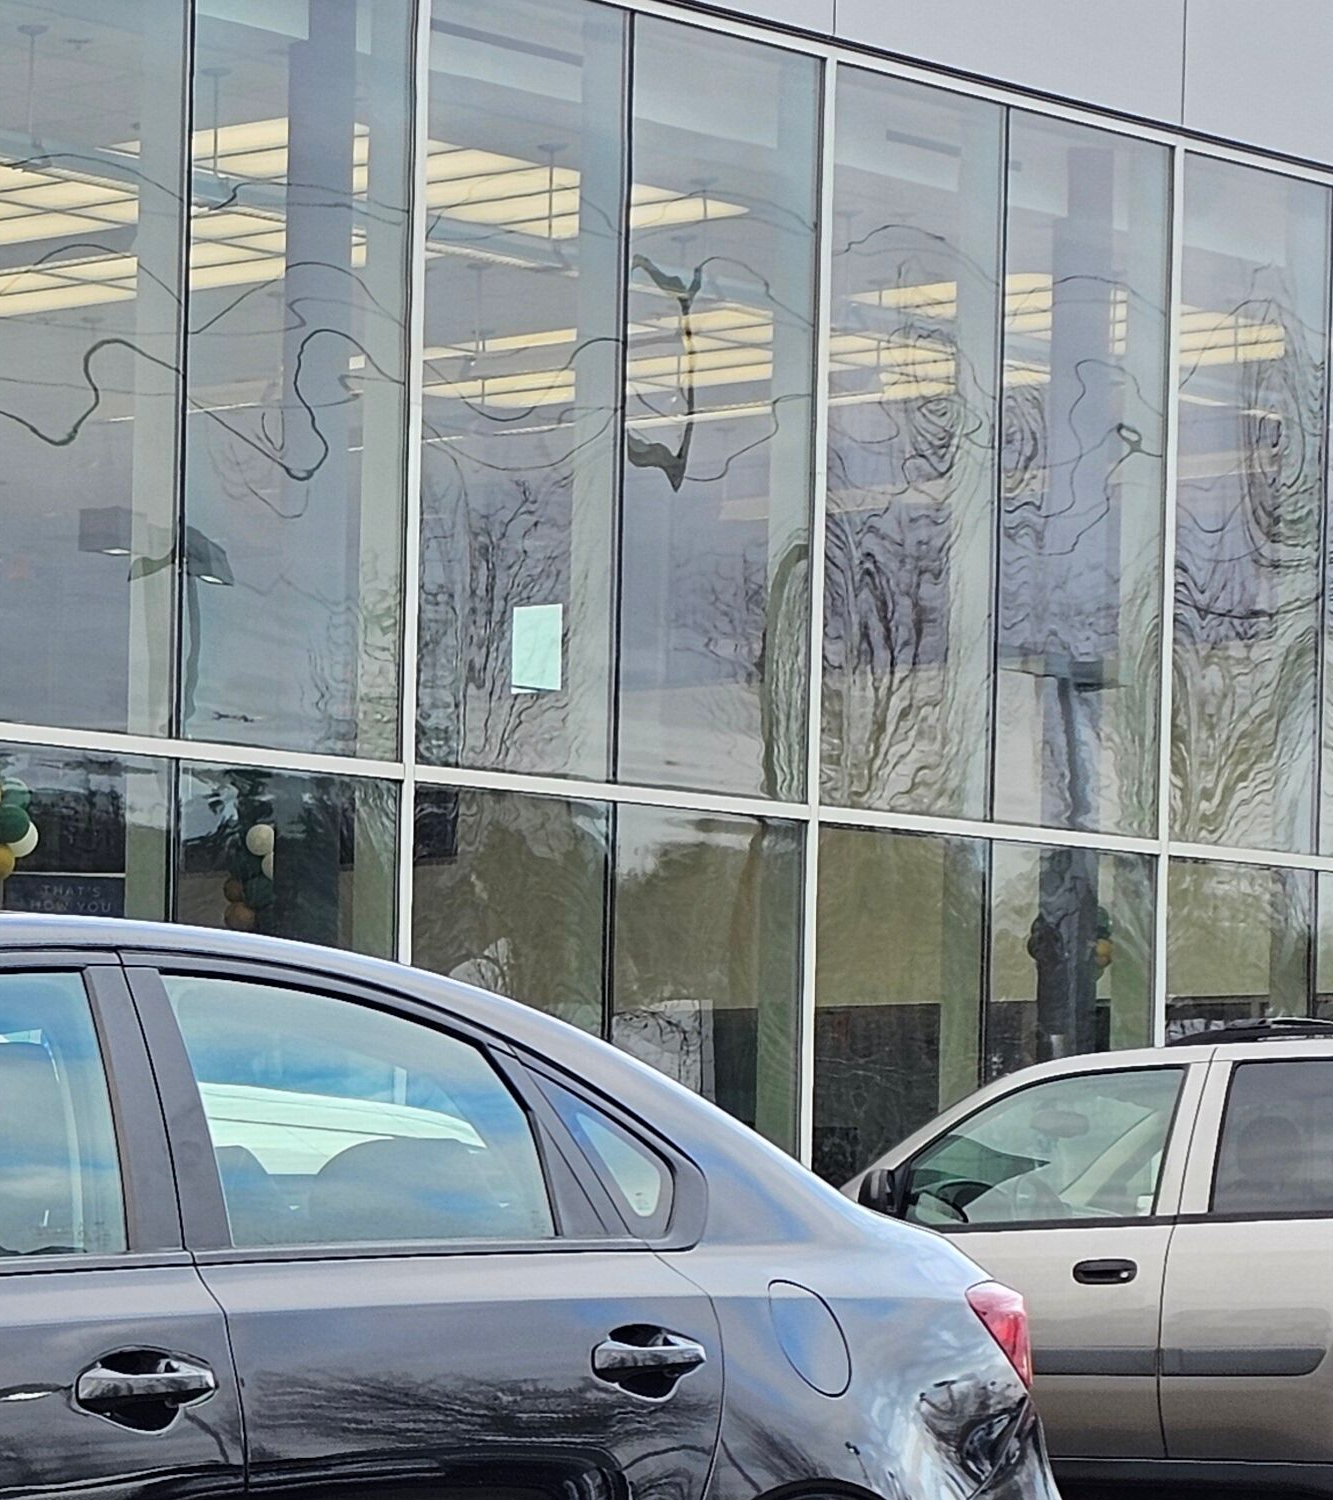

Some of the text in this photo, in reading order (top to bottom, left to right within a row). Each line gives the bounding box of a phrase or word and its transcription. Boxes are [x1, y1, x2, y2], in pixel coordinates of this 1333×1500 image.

[42, 884, 101, 898] THAT'S
[30, 900, 111, 913] HOW YOU
